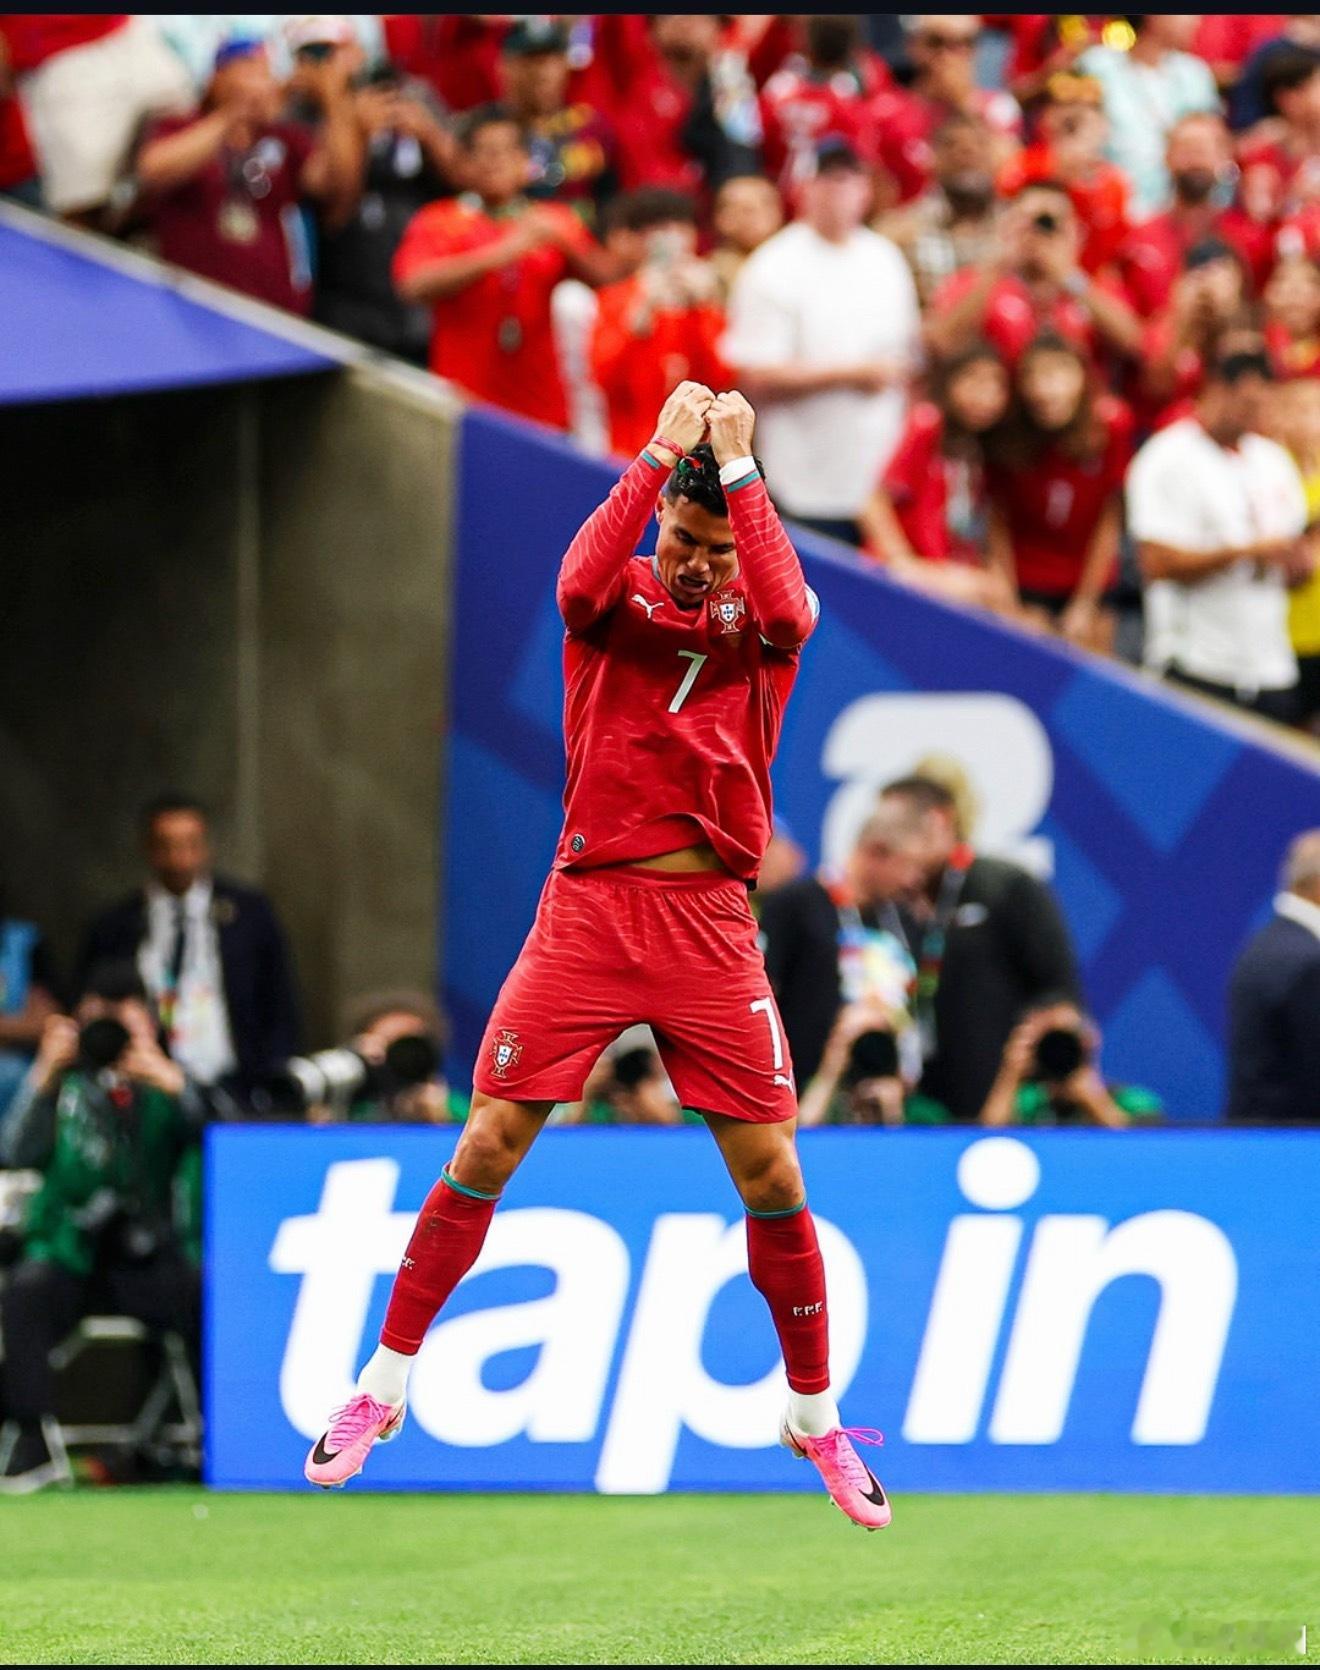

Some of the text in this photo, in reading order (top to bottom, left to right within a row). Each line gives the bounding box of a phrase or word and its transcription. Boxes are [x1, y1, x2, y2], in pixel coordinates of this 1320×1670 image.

[668, 650, 708, 713] 7
[750, 997, 783, 1070] 7
[269, 1136, 1238, 1494] tap in
